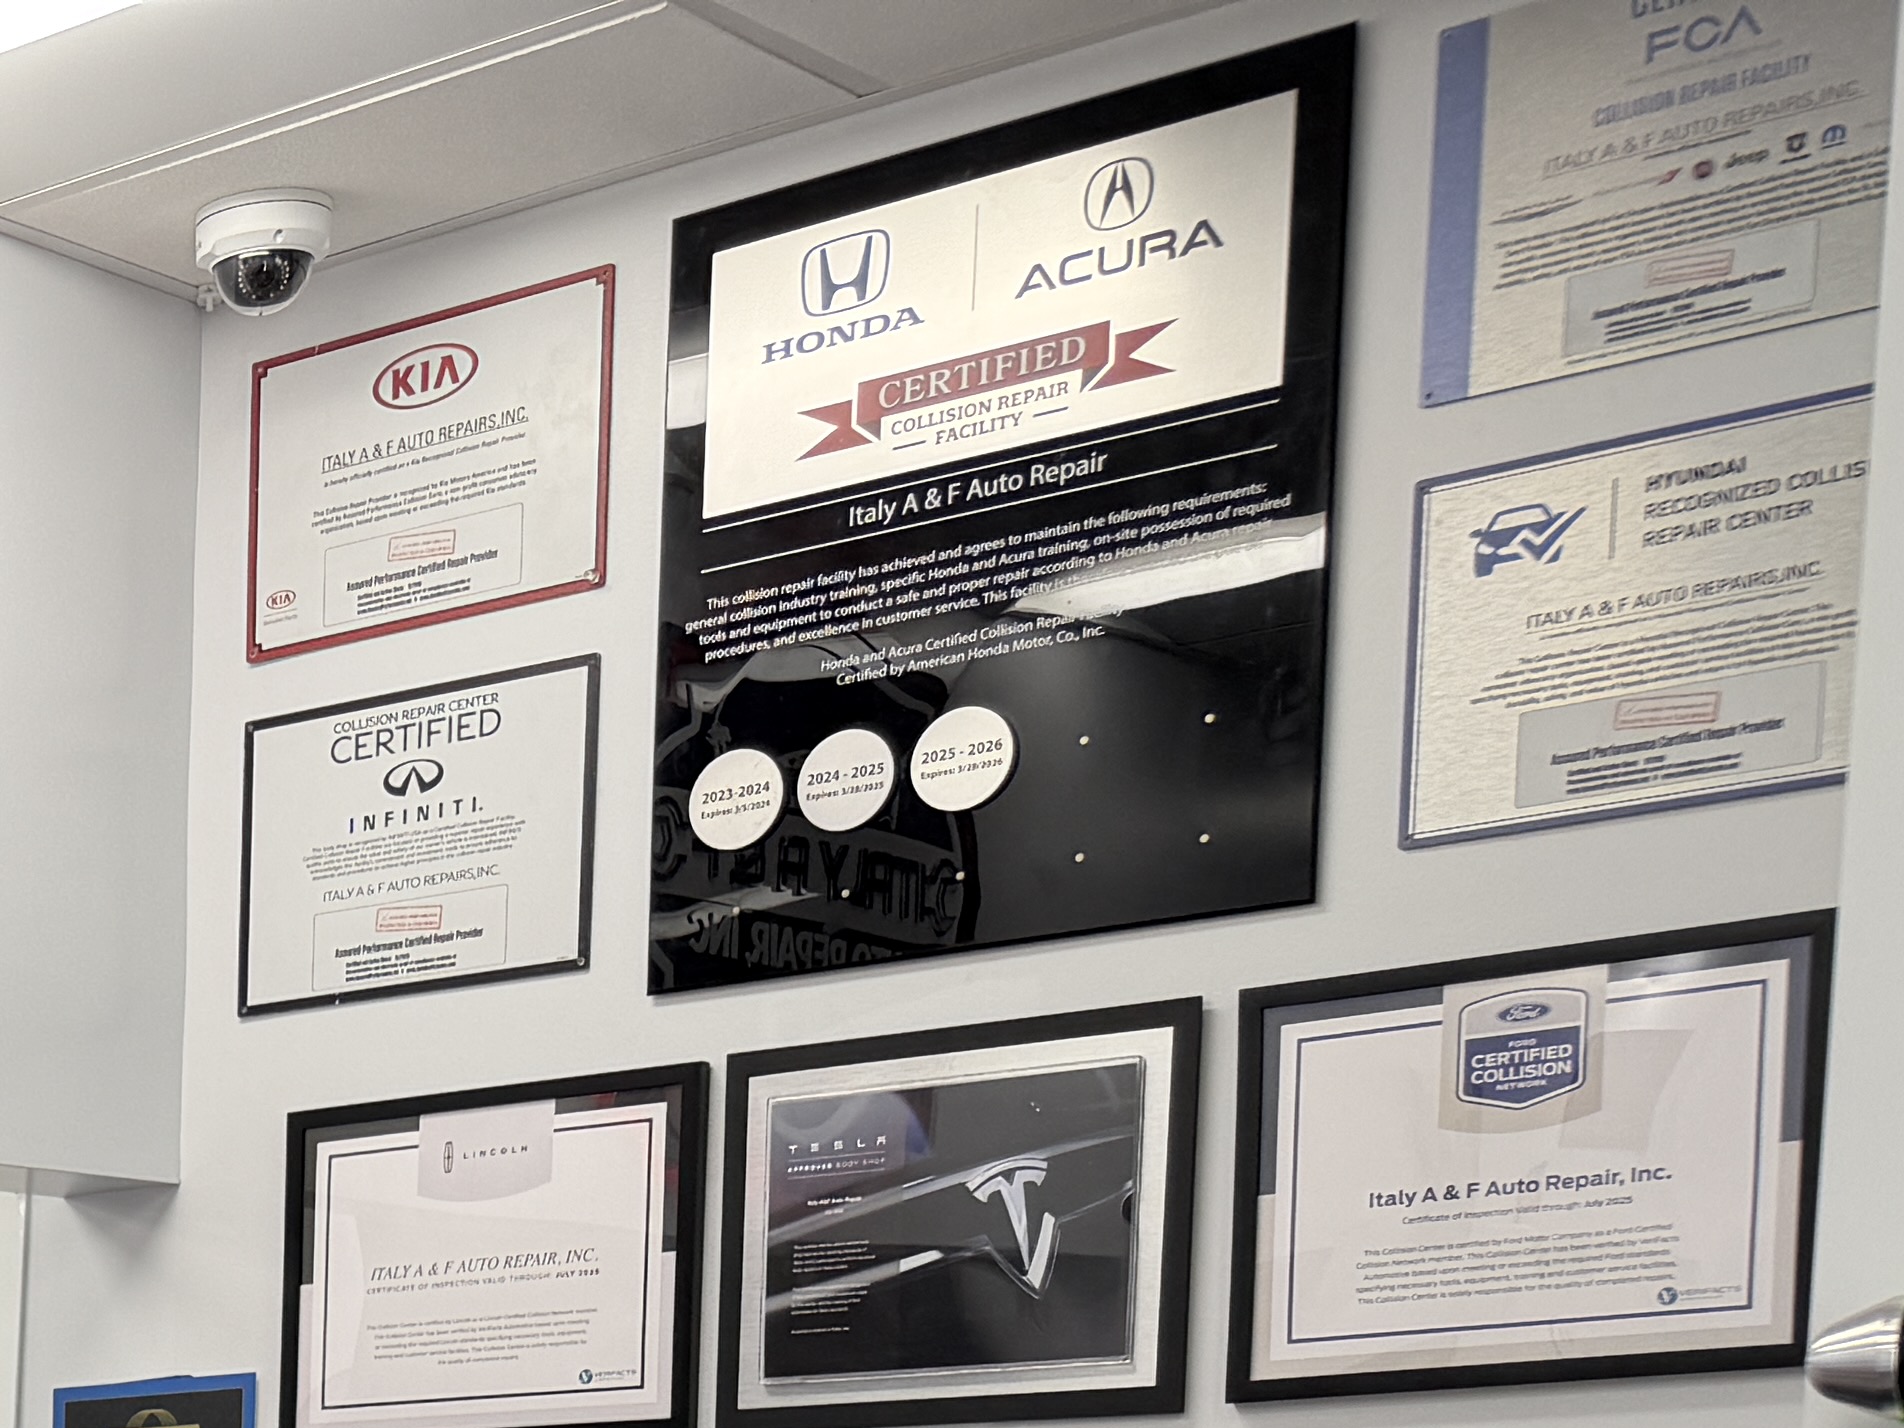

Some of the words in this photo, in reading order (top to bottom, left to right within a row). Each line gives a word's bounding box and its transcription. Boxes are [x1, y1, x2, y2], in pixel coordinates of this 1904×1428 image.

[1645, 6, 1763, 65] FCA
[1015, 219, 1224, 299] ACURA
[761, 307, 924, 365] HONDA
[392, 354, 460, 401] KIA
[879, 335, 1086, 408] CERTIFIED
[890, 399, 993, 436] COLLISION
[998, 382, 1069, 411] REPAIR
[935, 413, 1023, 445] FACILITY
[849, 501, 896, 530] Italy
[903, 494, 919, 515] A
[926, 488, 943, 511] &
[949, 484, 960, 506] F
[967, 469, 1024, 503] Auto
[1030, 452, 1107, 493] Repair
[1643, 518, 1720, 548] REPAIR
[1725, 500, 1813, 531] CENTER
[330, 709, 501, 764] CERTIFIED
[334, 712, 399, 734] COLLISION
[402, 703, 445, 720] REPAIR
[449, 692, 499, 712] CENTER
[350, 797, 478, 834] INFINITI
[1471, 1060, 1571, 1084] COLLISION
[1472, 1043, 1573, 1068] CERTIFIED
[463, 1144, 529, 1160] LINCOLN
[789, 1135, 887, 1154] TESLA
